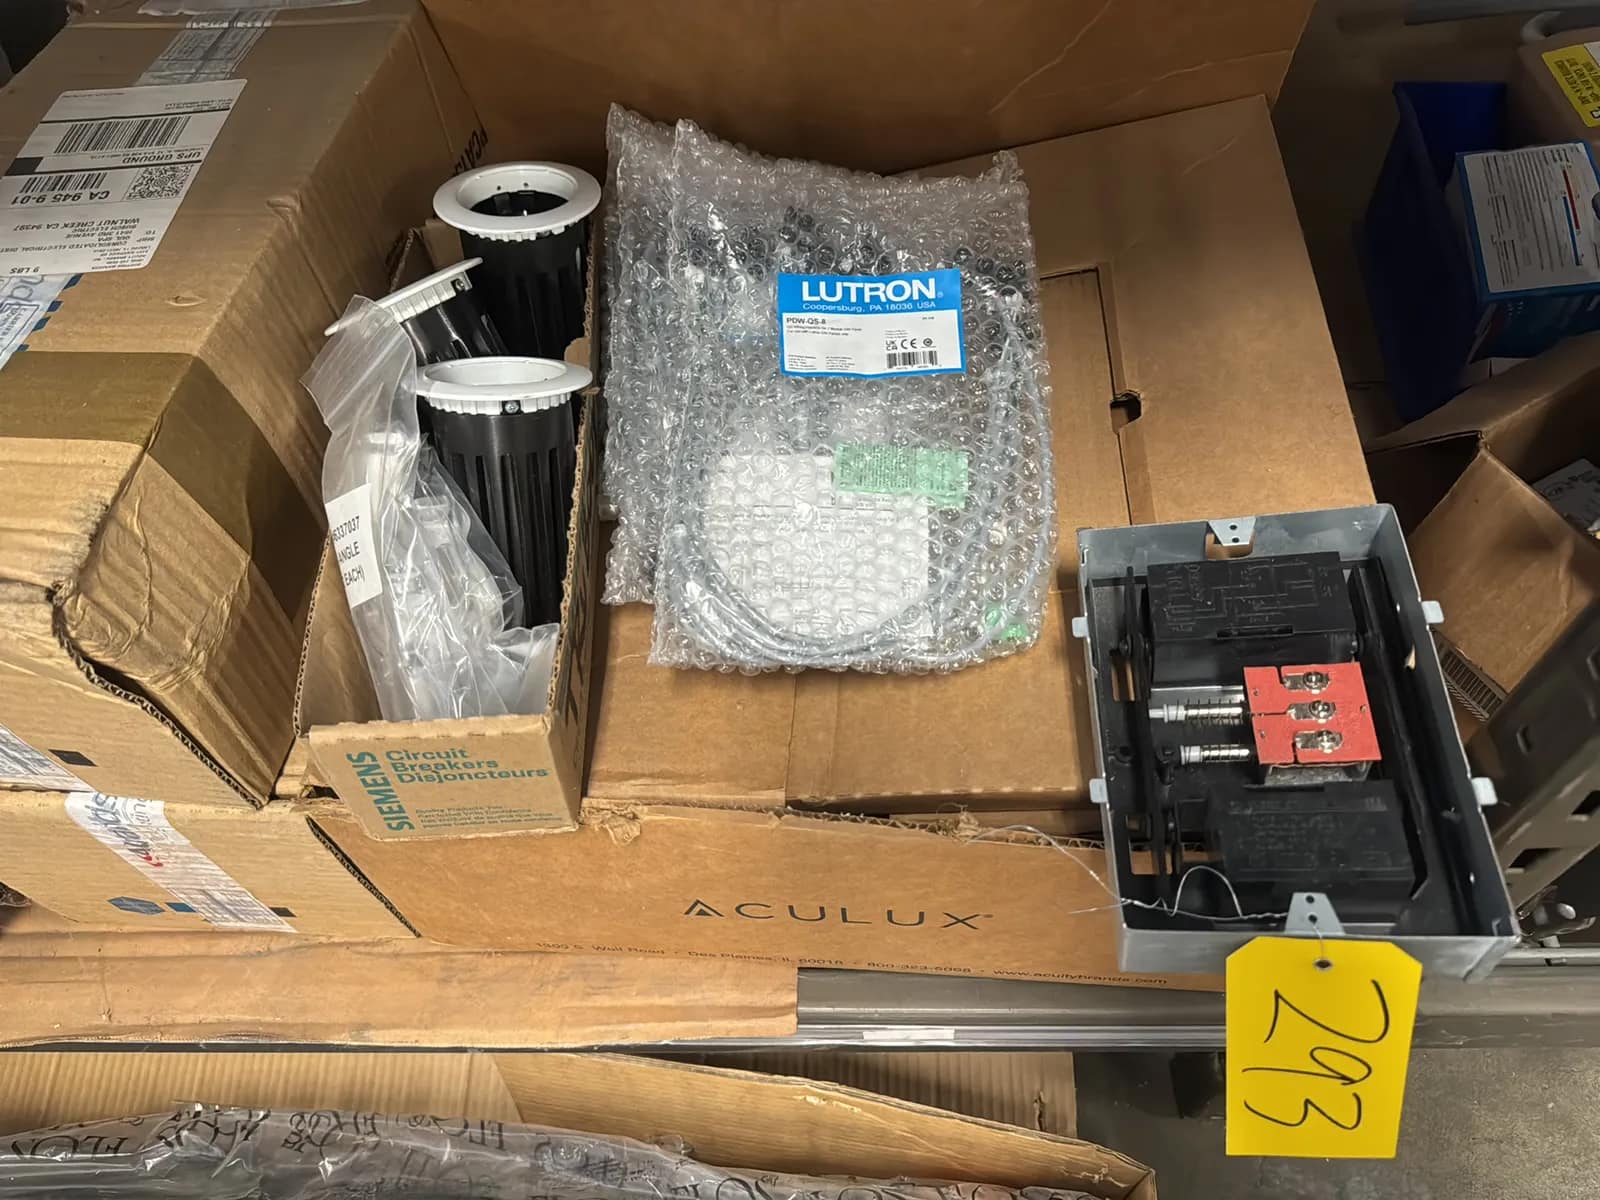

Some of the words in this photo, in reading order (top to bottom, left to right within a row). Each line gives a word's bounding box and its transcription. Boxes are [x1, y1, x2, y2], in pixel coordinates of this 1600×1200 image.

[122, 153, 173, 164] GROUND
[177, 151, 201, 160] UPS
[11, 194, 48, 205] 9-01
[52, 192, 82, 203] 945
[89, 190, 110, 200] CA
[60, 221, 95, 229] CREEK
[97, 217, 140, 227] WALNUT
[802, 277, 936, 303] LUTRON
[803, 303, 866, 313] Coopersburg,
[869, 304, 882, 312] PA
[886, 303, 912, 311] 18036
[917, 301, 936, 310] USA
[786, 317, 827, 325] PDW-QS-8
[385, 747, 470, 761] Circuit
[391, 759, 499, 773] Breakers
[398, 768, 550, 784] Disjoncteurs
[346, 751, 415, 831] SIEMENS
[683, 898, 981, 930] ACULUX
[1241, 978, 1390, 1131] 293
